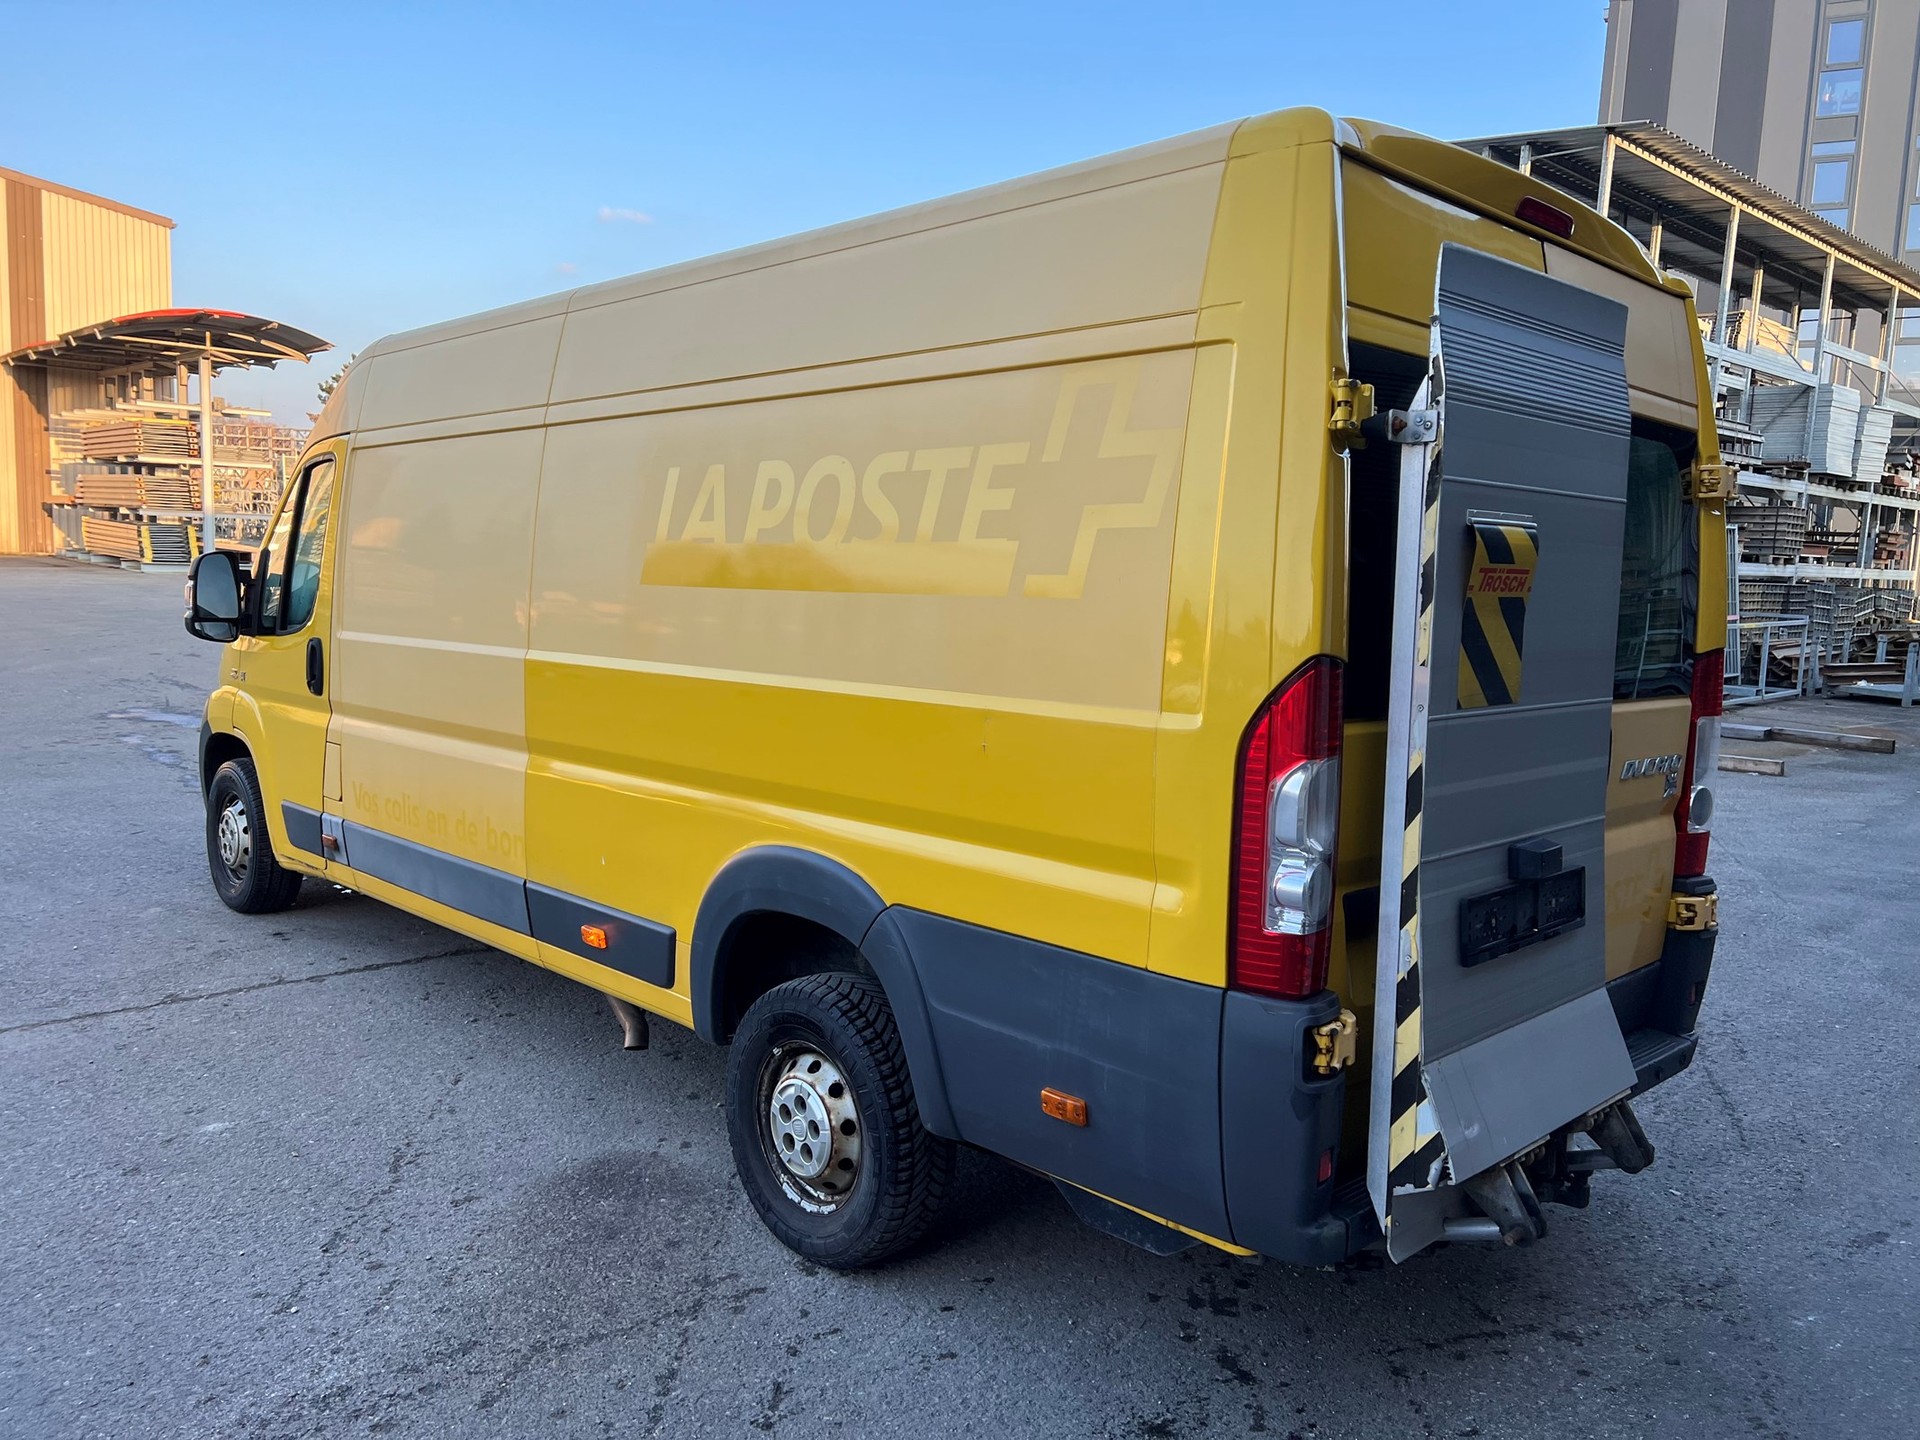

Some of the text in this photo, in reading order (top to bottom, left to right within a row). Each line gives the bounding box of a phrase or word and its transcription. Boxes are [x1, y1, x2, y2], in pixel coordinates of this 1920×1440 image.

[743, 441, 1031, 546] POSTE
[352, 781, 379, 815] Vos
[384, 792, 420, 828] colis
[426, 809, 448, 837] en
[455, 810, 478, 846] de
